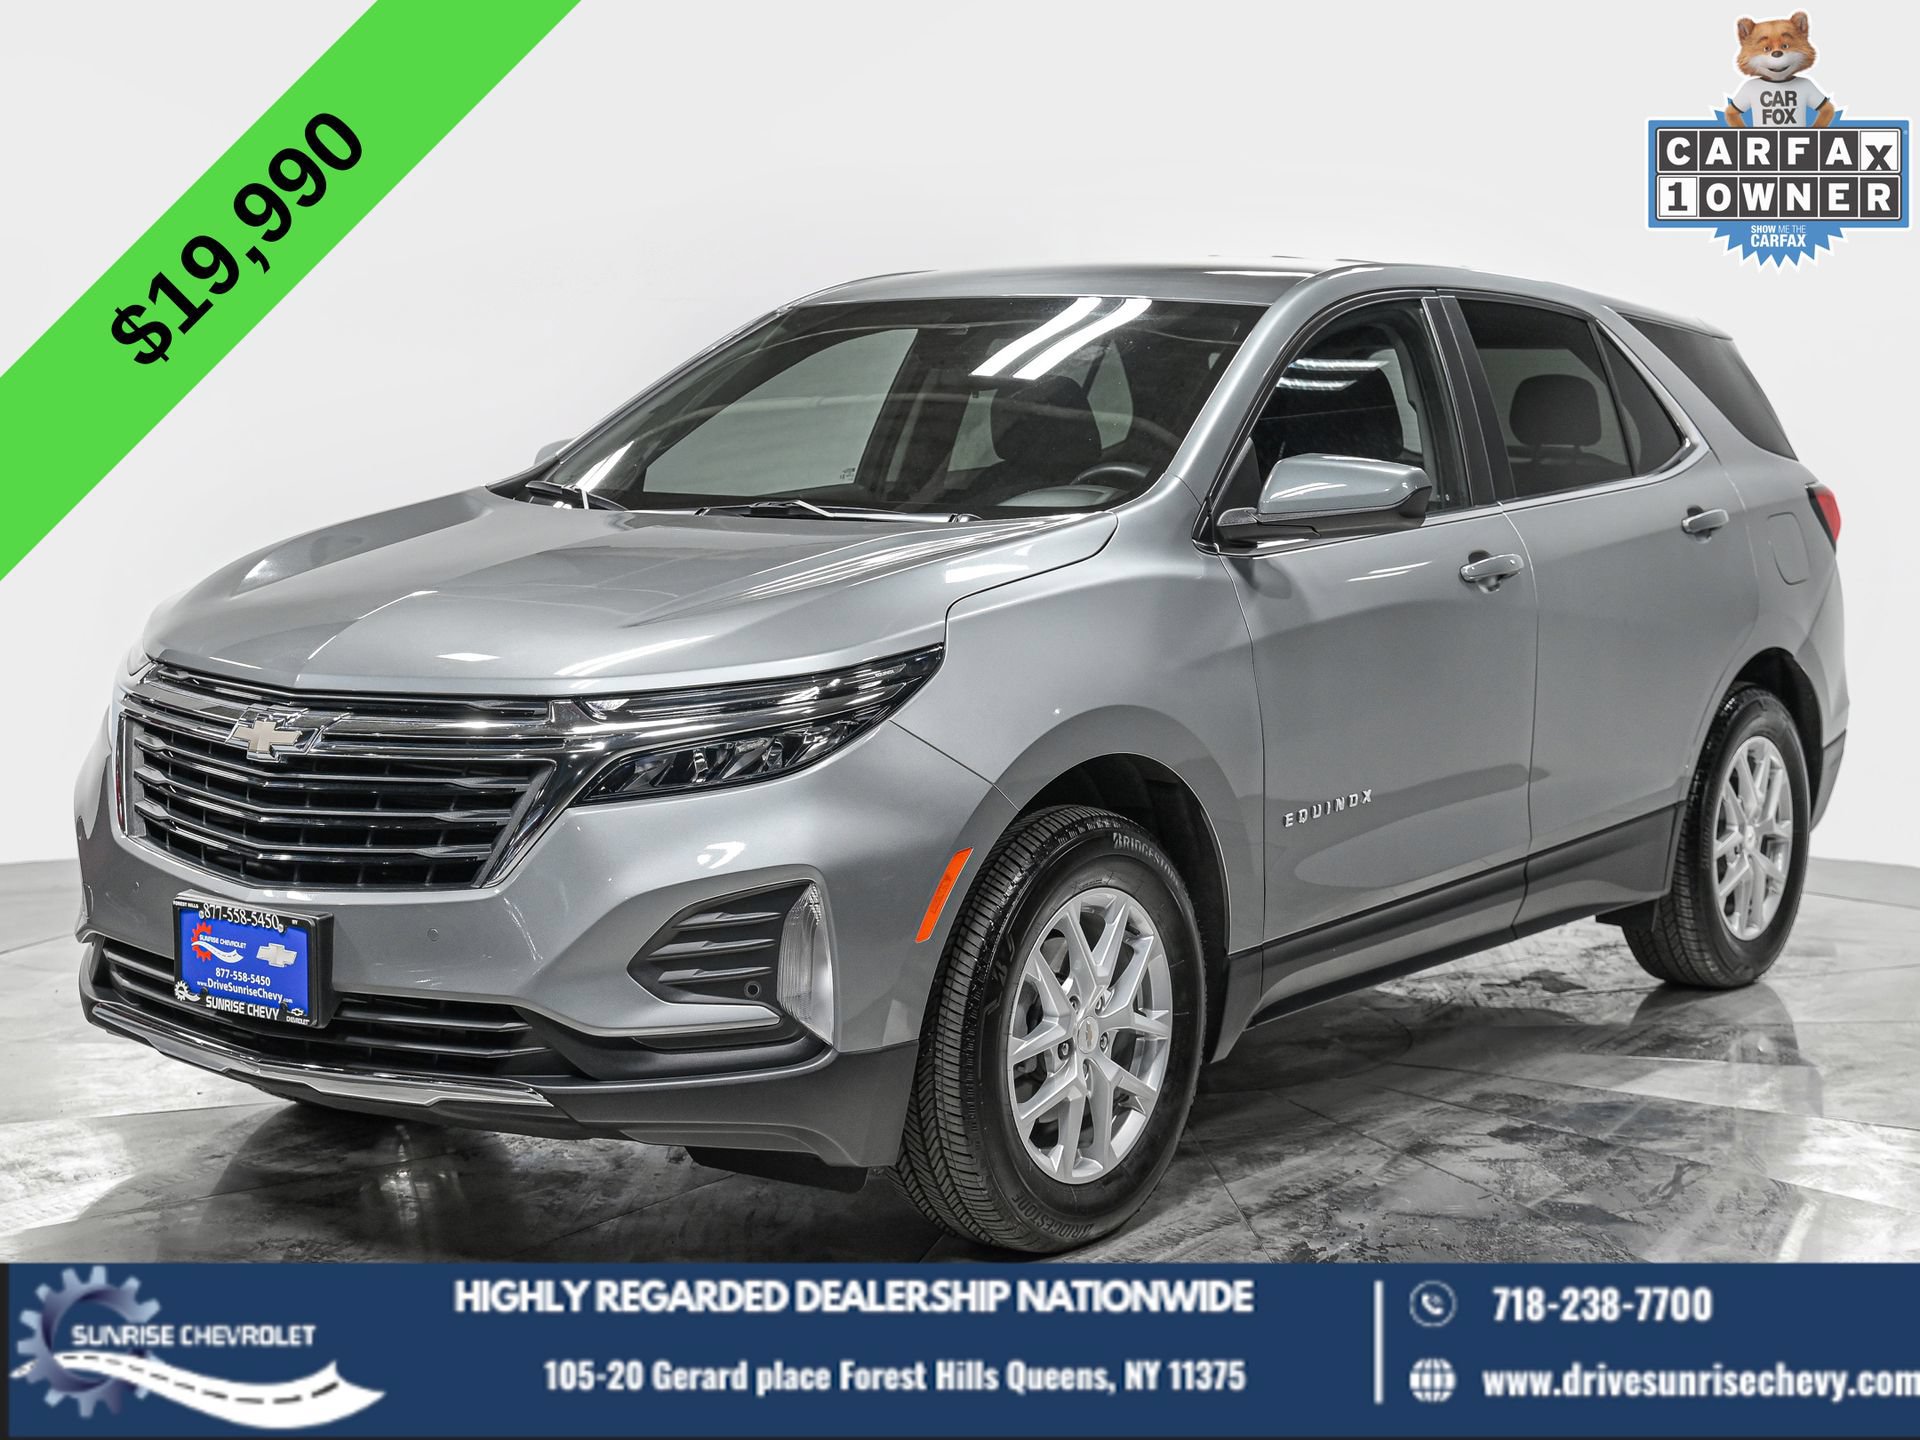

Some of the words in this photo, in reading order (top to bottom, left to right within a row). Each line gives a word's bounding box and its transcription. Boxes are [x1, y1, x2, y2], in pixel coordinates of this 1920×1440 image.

[1284, 789, 1372, 828] EQUINOX
[203, 903, 280, 930] 877-558-5450
[215, 967, 271, 987] 877-558-5450
[205, 996, 245, 1014] SUNRISE
[247, 1003, 280, 1021] CHEVY
